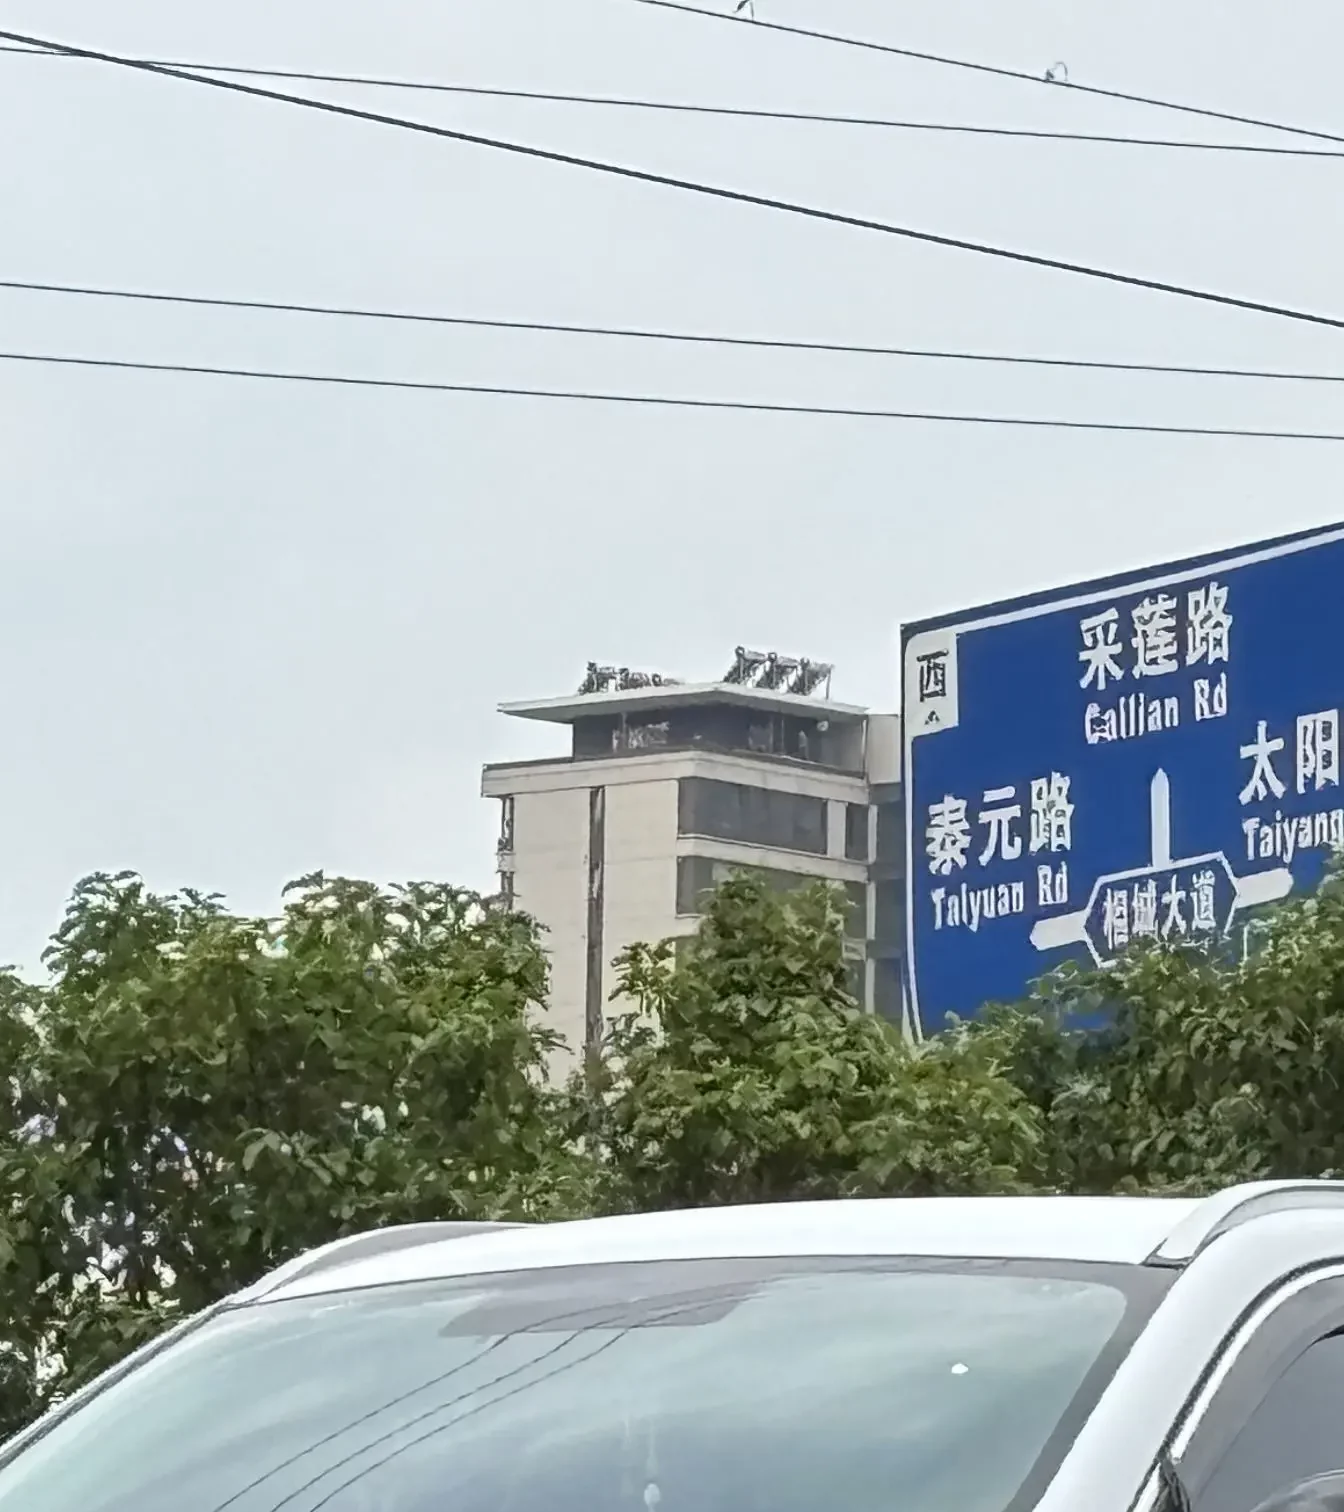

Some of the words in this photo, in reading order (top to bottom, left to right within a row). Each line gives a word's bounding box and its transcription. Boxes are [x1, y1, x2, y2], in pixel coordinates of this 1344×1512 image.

[1078, 581, 1234, 691] 采莲路
[916, 648, 949, 702] 西
[1084, 692, 1180, 745] Cailian
[1193, 671, 1228, 722] Rd
[925, 770, 1075, 876] 泰元路
[1241, 808, 1344, 863] Taiyang
[930, 880, 1025, 934] Taiyuan
[1036, 860, 1069, 907] Rd
